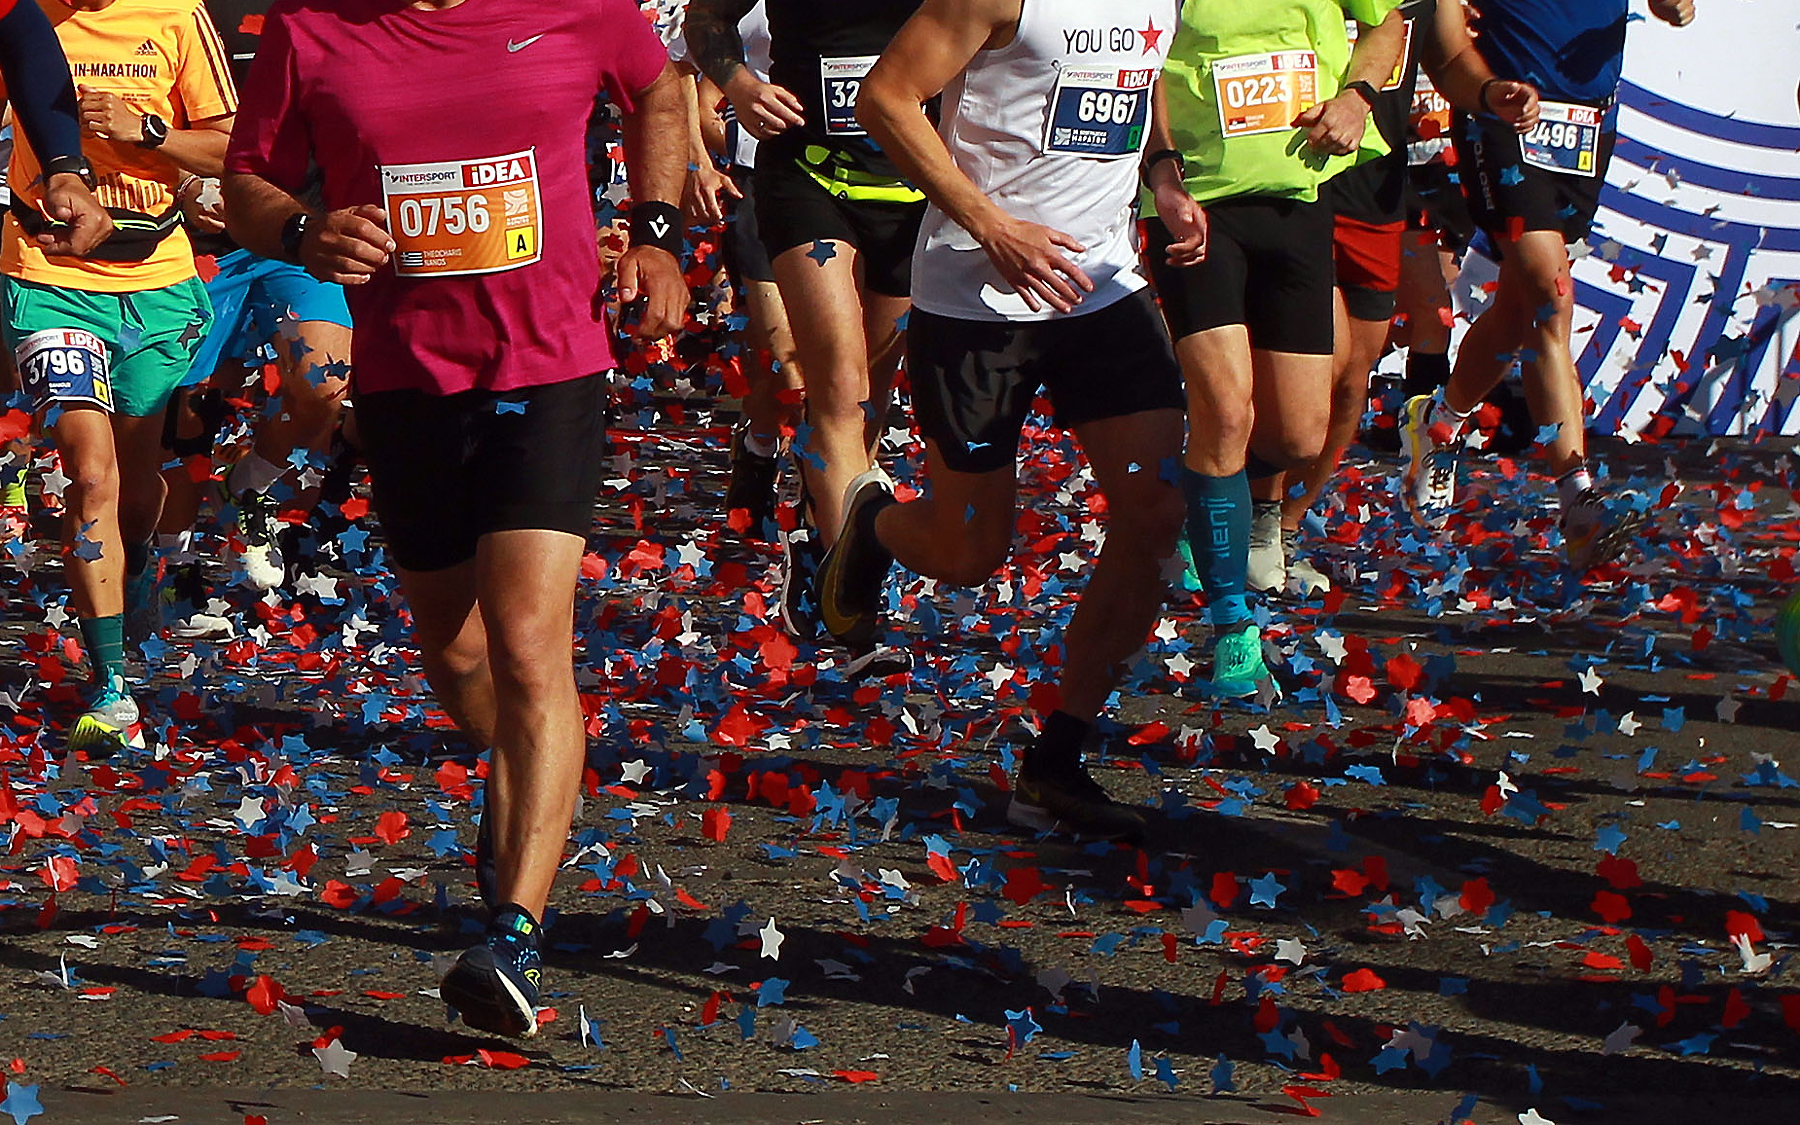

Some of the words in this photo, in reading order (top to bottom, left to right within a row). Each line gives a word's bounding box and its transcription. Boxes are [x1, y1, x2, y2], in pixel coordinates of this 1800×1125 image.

[1063, 29, 1102, 55] YOU
[1109, 27, 1135, 52] GO
[74, 63, 157, 78] IN-MARATHON
[1072, 71, 1114, 79] INTERSPORT
[1124, 70, 1149, 87] iDEA
[831, 80, 861, 108] 32
[1226, 75, 1294, 108] 0223
[1078, 91, 1138, 125] 6967
[399, 171, 457, 183] INTERSPORT
[471, 160, 526, 185] iDEA
[400, 194, 490, 238] 0756
[516, 234, 527, 253] A
[69, 333, 101, 355] iDEA
[26, 350, 85, 385] 3796
